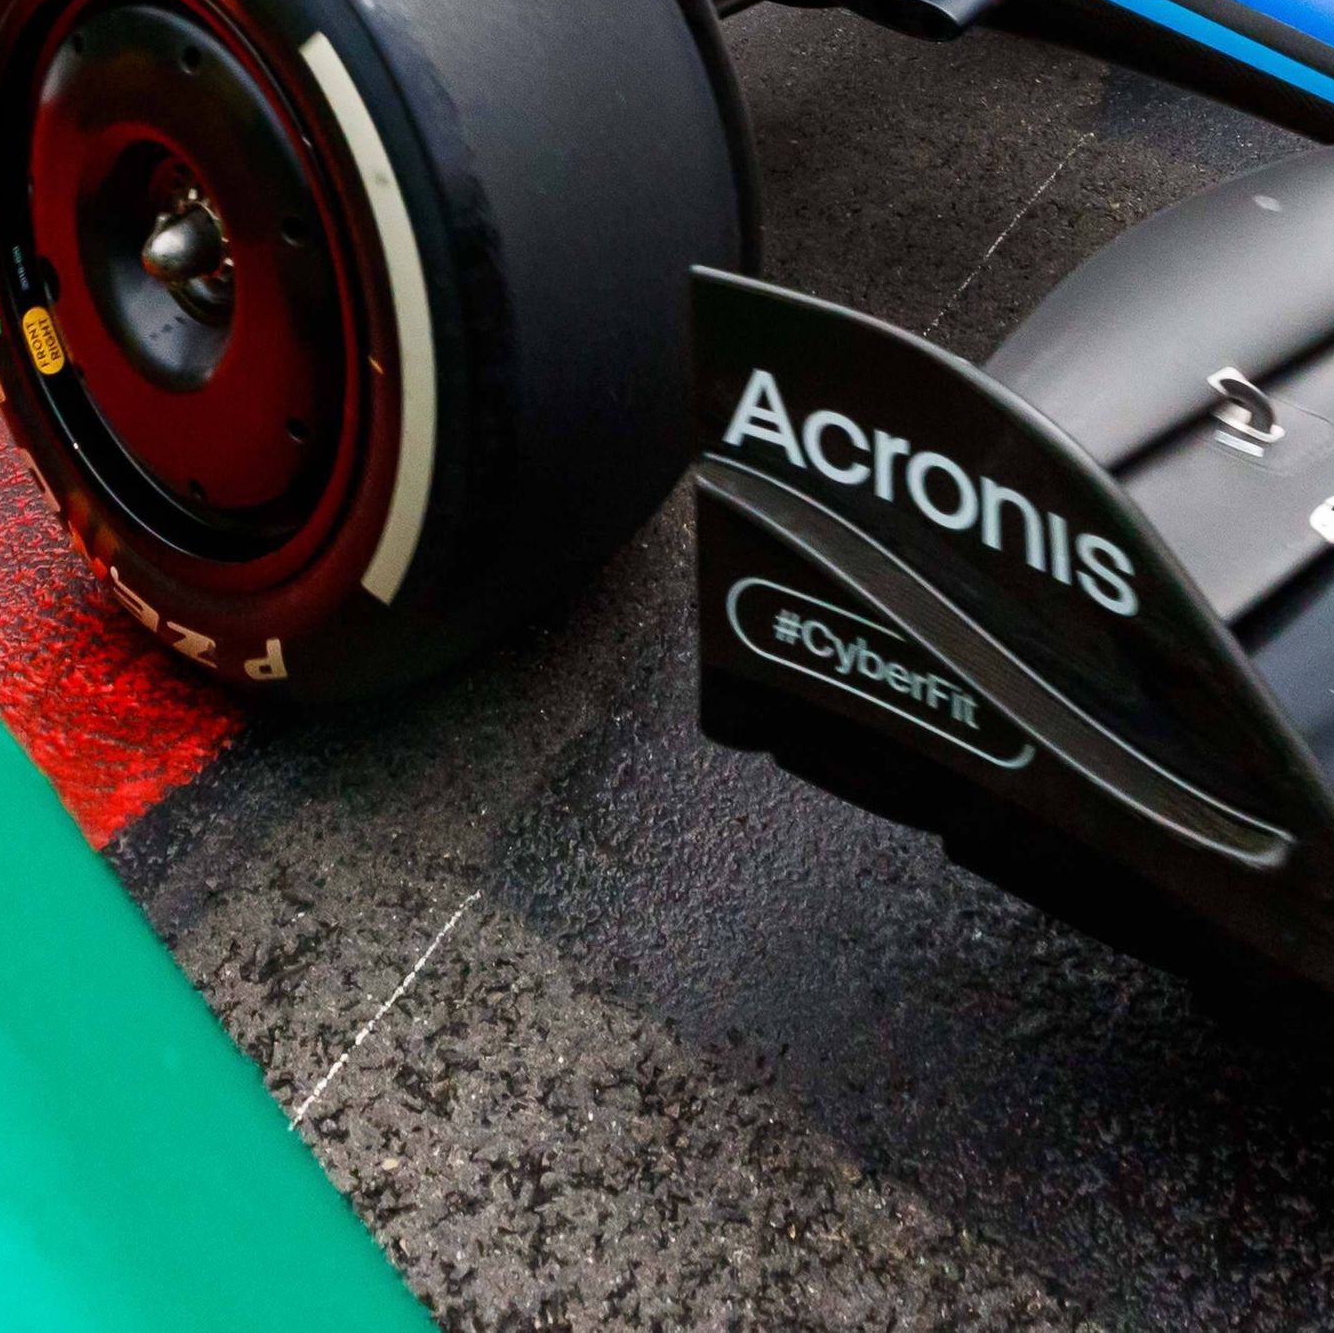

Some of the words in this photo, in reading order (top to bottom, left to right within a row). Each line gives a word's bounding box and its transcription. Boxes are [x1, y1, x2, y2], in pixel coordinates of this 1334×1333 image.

[25, 322, 48, 368] FRONT
[37, 316, 62, 361] RIGHT
[723, 368, 1140, 618] Acronis
[773, 608, 982, 731] #CyberFit
